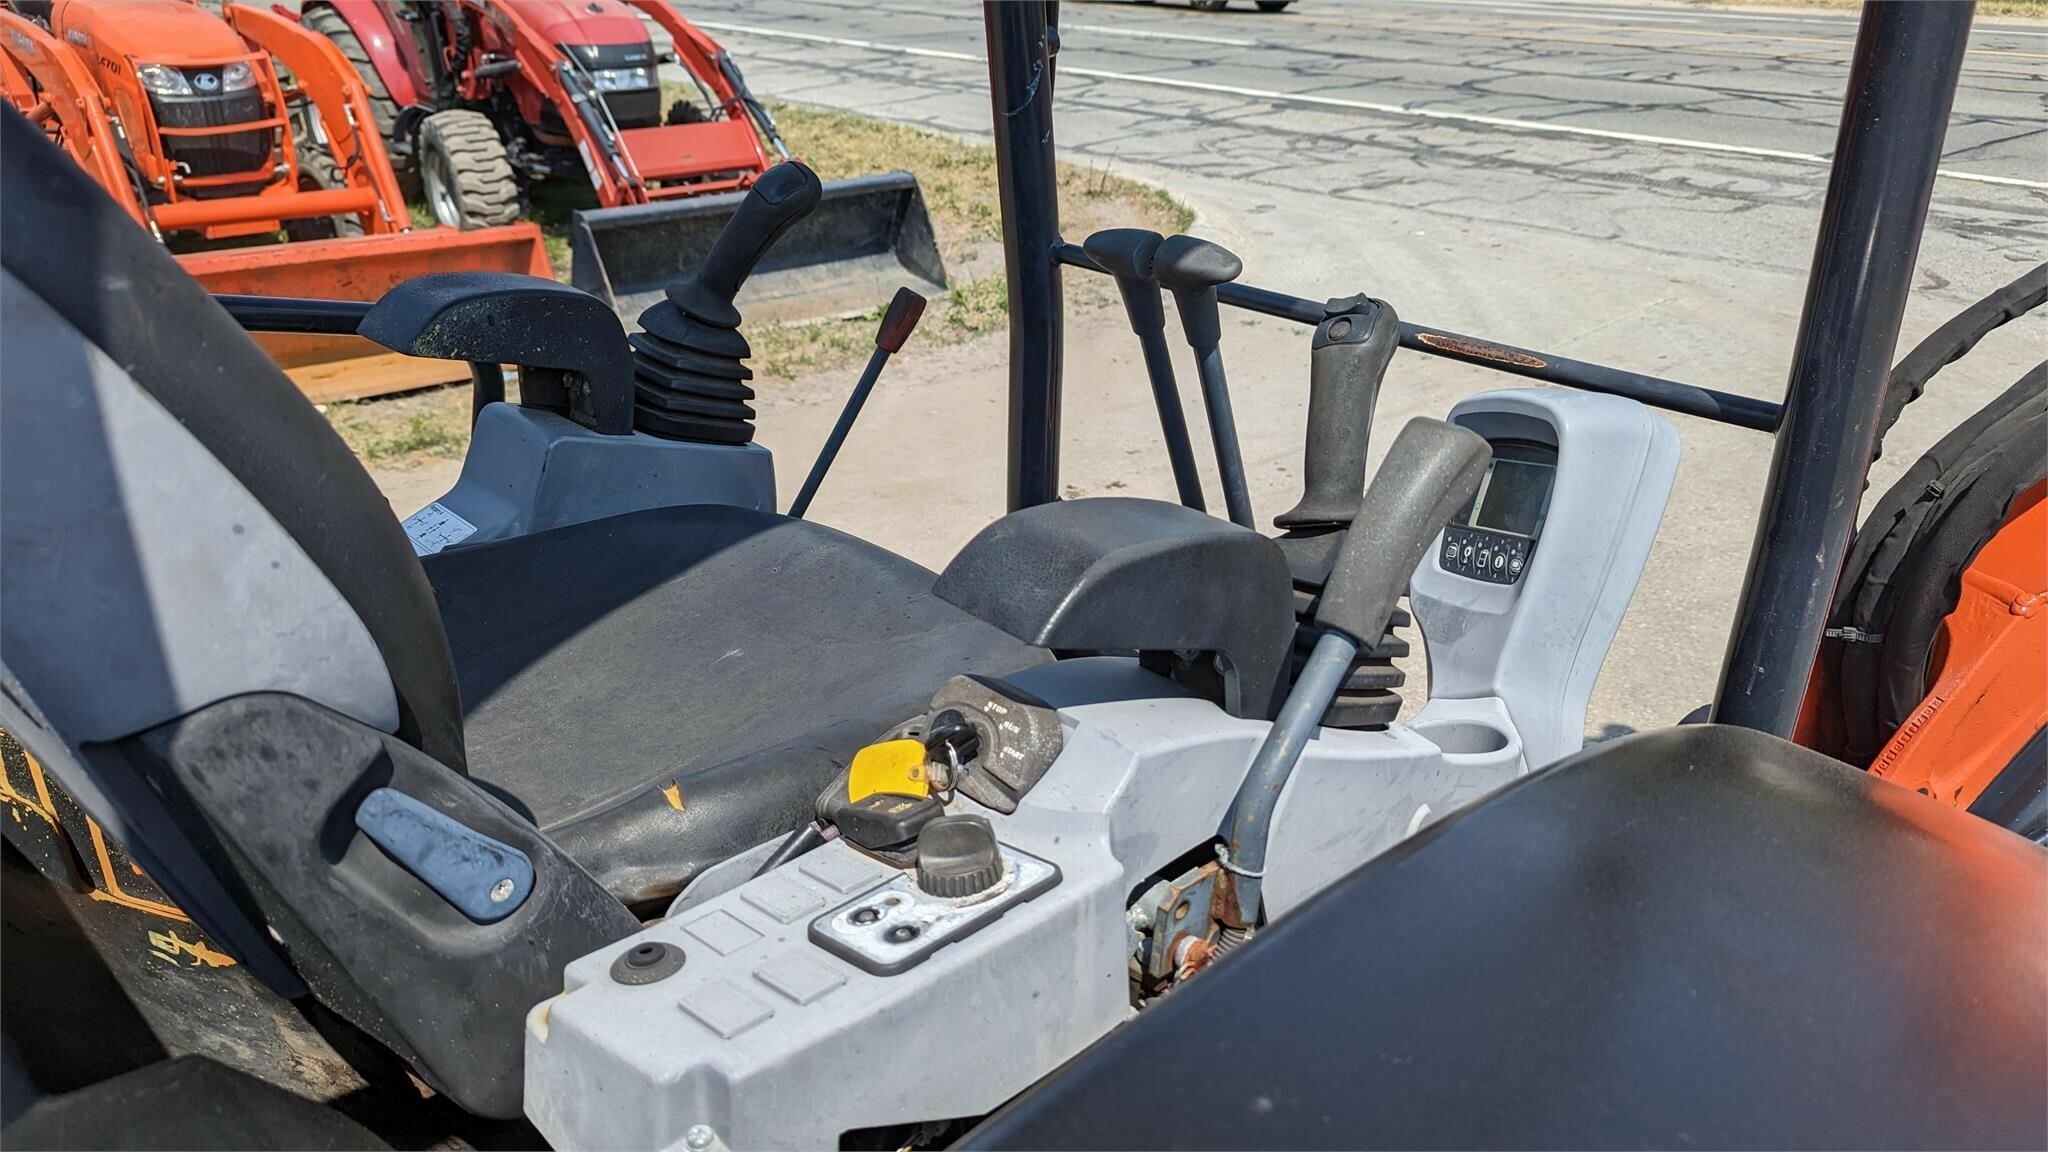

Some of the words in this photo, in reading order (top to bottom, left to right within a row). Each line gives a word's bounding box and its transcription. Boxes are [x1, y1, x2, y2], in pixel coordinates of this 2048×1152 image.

[987, 701, 1008, 714] STOP
[1003, 720, 1021, 734] RUN
[1002, 746, 1025, 760] START
